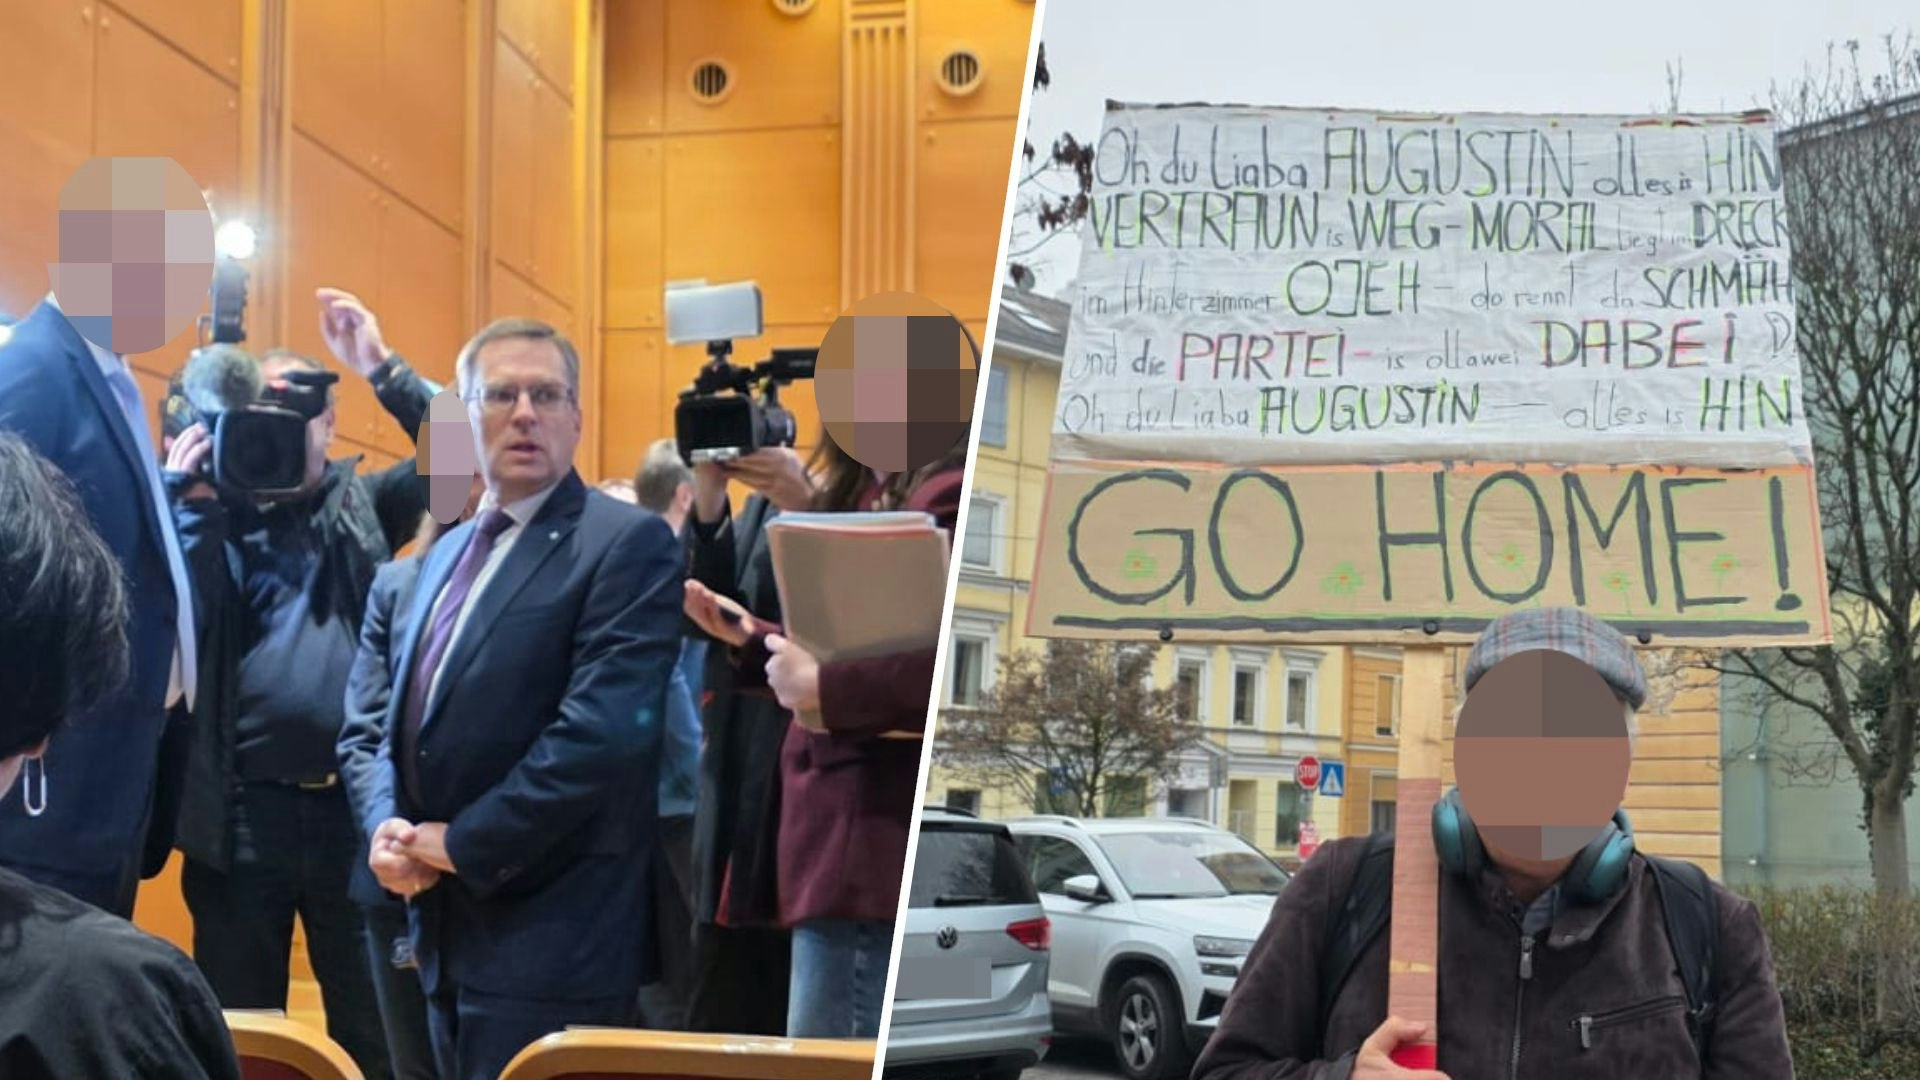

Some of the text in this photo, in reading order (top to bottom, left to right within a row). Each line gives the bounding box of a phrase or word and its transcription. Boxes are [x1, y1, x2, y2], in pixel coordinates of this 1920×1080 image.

[1096, 127, 1149, 186] Oh
[1161, 124, 1197, 185] du
[1703, 127, 1782, 193] HIN
[1090, 190, 1319, 250] VERTRAUN
[1326, 228, 1344, 248] is
[1692, 199, 1790, 250] DRECK
[1287, 259, 1420, 317] OJEH
[1641, 254, 1793, 310] SCHMÄH
[1131, 338, 1167, 376] die
[1387, 348, 1405, 370] is
[1529, 311, 1738, 370] DABEI
[1063, 392, 1104, 434] Oh
[1126, 387, 1160, 432] du
[1258, 377, 1480, 435] AUGUSTIN
[1700, 373, 1792, 432] HIN
[1068, 468, 1802, 612] GO HOME!
[1299, 765, 1318, 779] STOP
